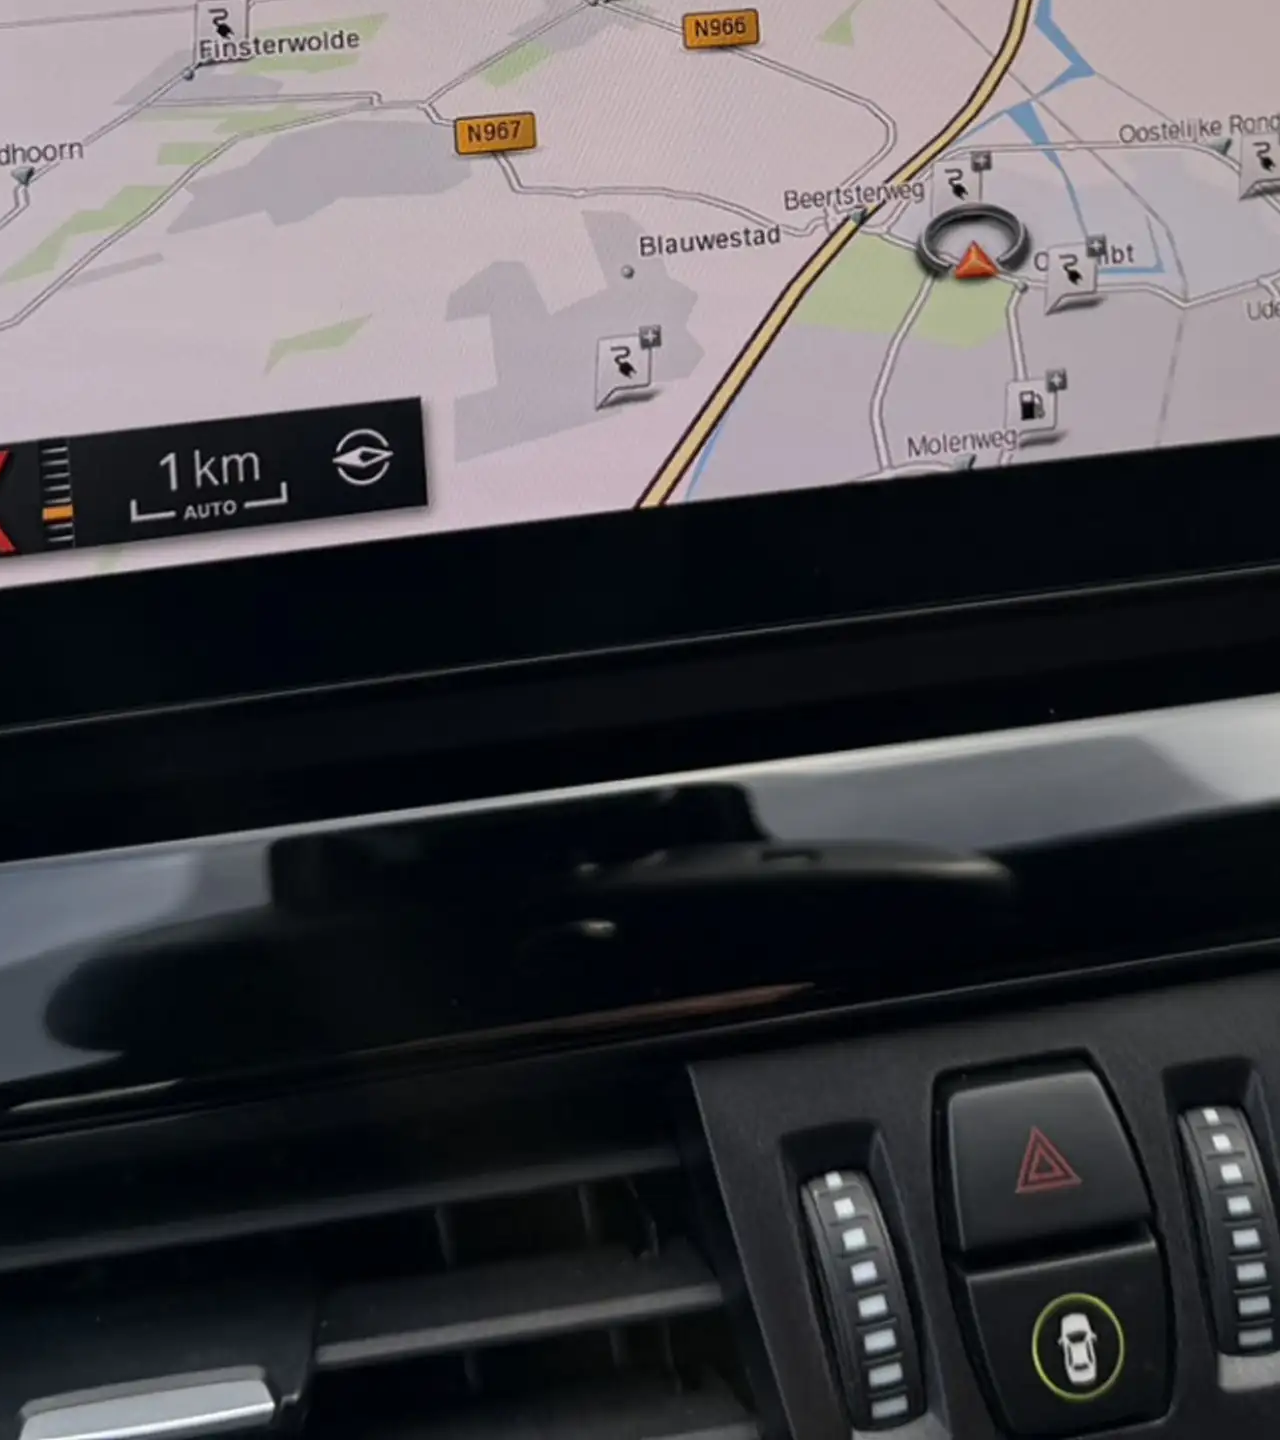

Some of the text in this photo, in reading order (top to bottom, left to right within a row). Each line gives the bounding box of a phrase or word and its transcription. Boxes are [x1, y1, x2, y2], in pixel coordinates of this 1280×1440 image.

[693, 16, 748, 40] N966
[199, 27, 361, 62] Finsterwolde
[468, 120, 522, 145] N967
[1119, 118, 1223, 144] Oostelijke
[784, 176, 925, 214] Beertsterweg
[639, 224, 782, 258] Blauwestad
[907, 426, 1018, 458] Molenweg
[160, 449, 260, 491] 1 km
[183, 499, 238, 521] AUTO
